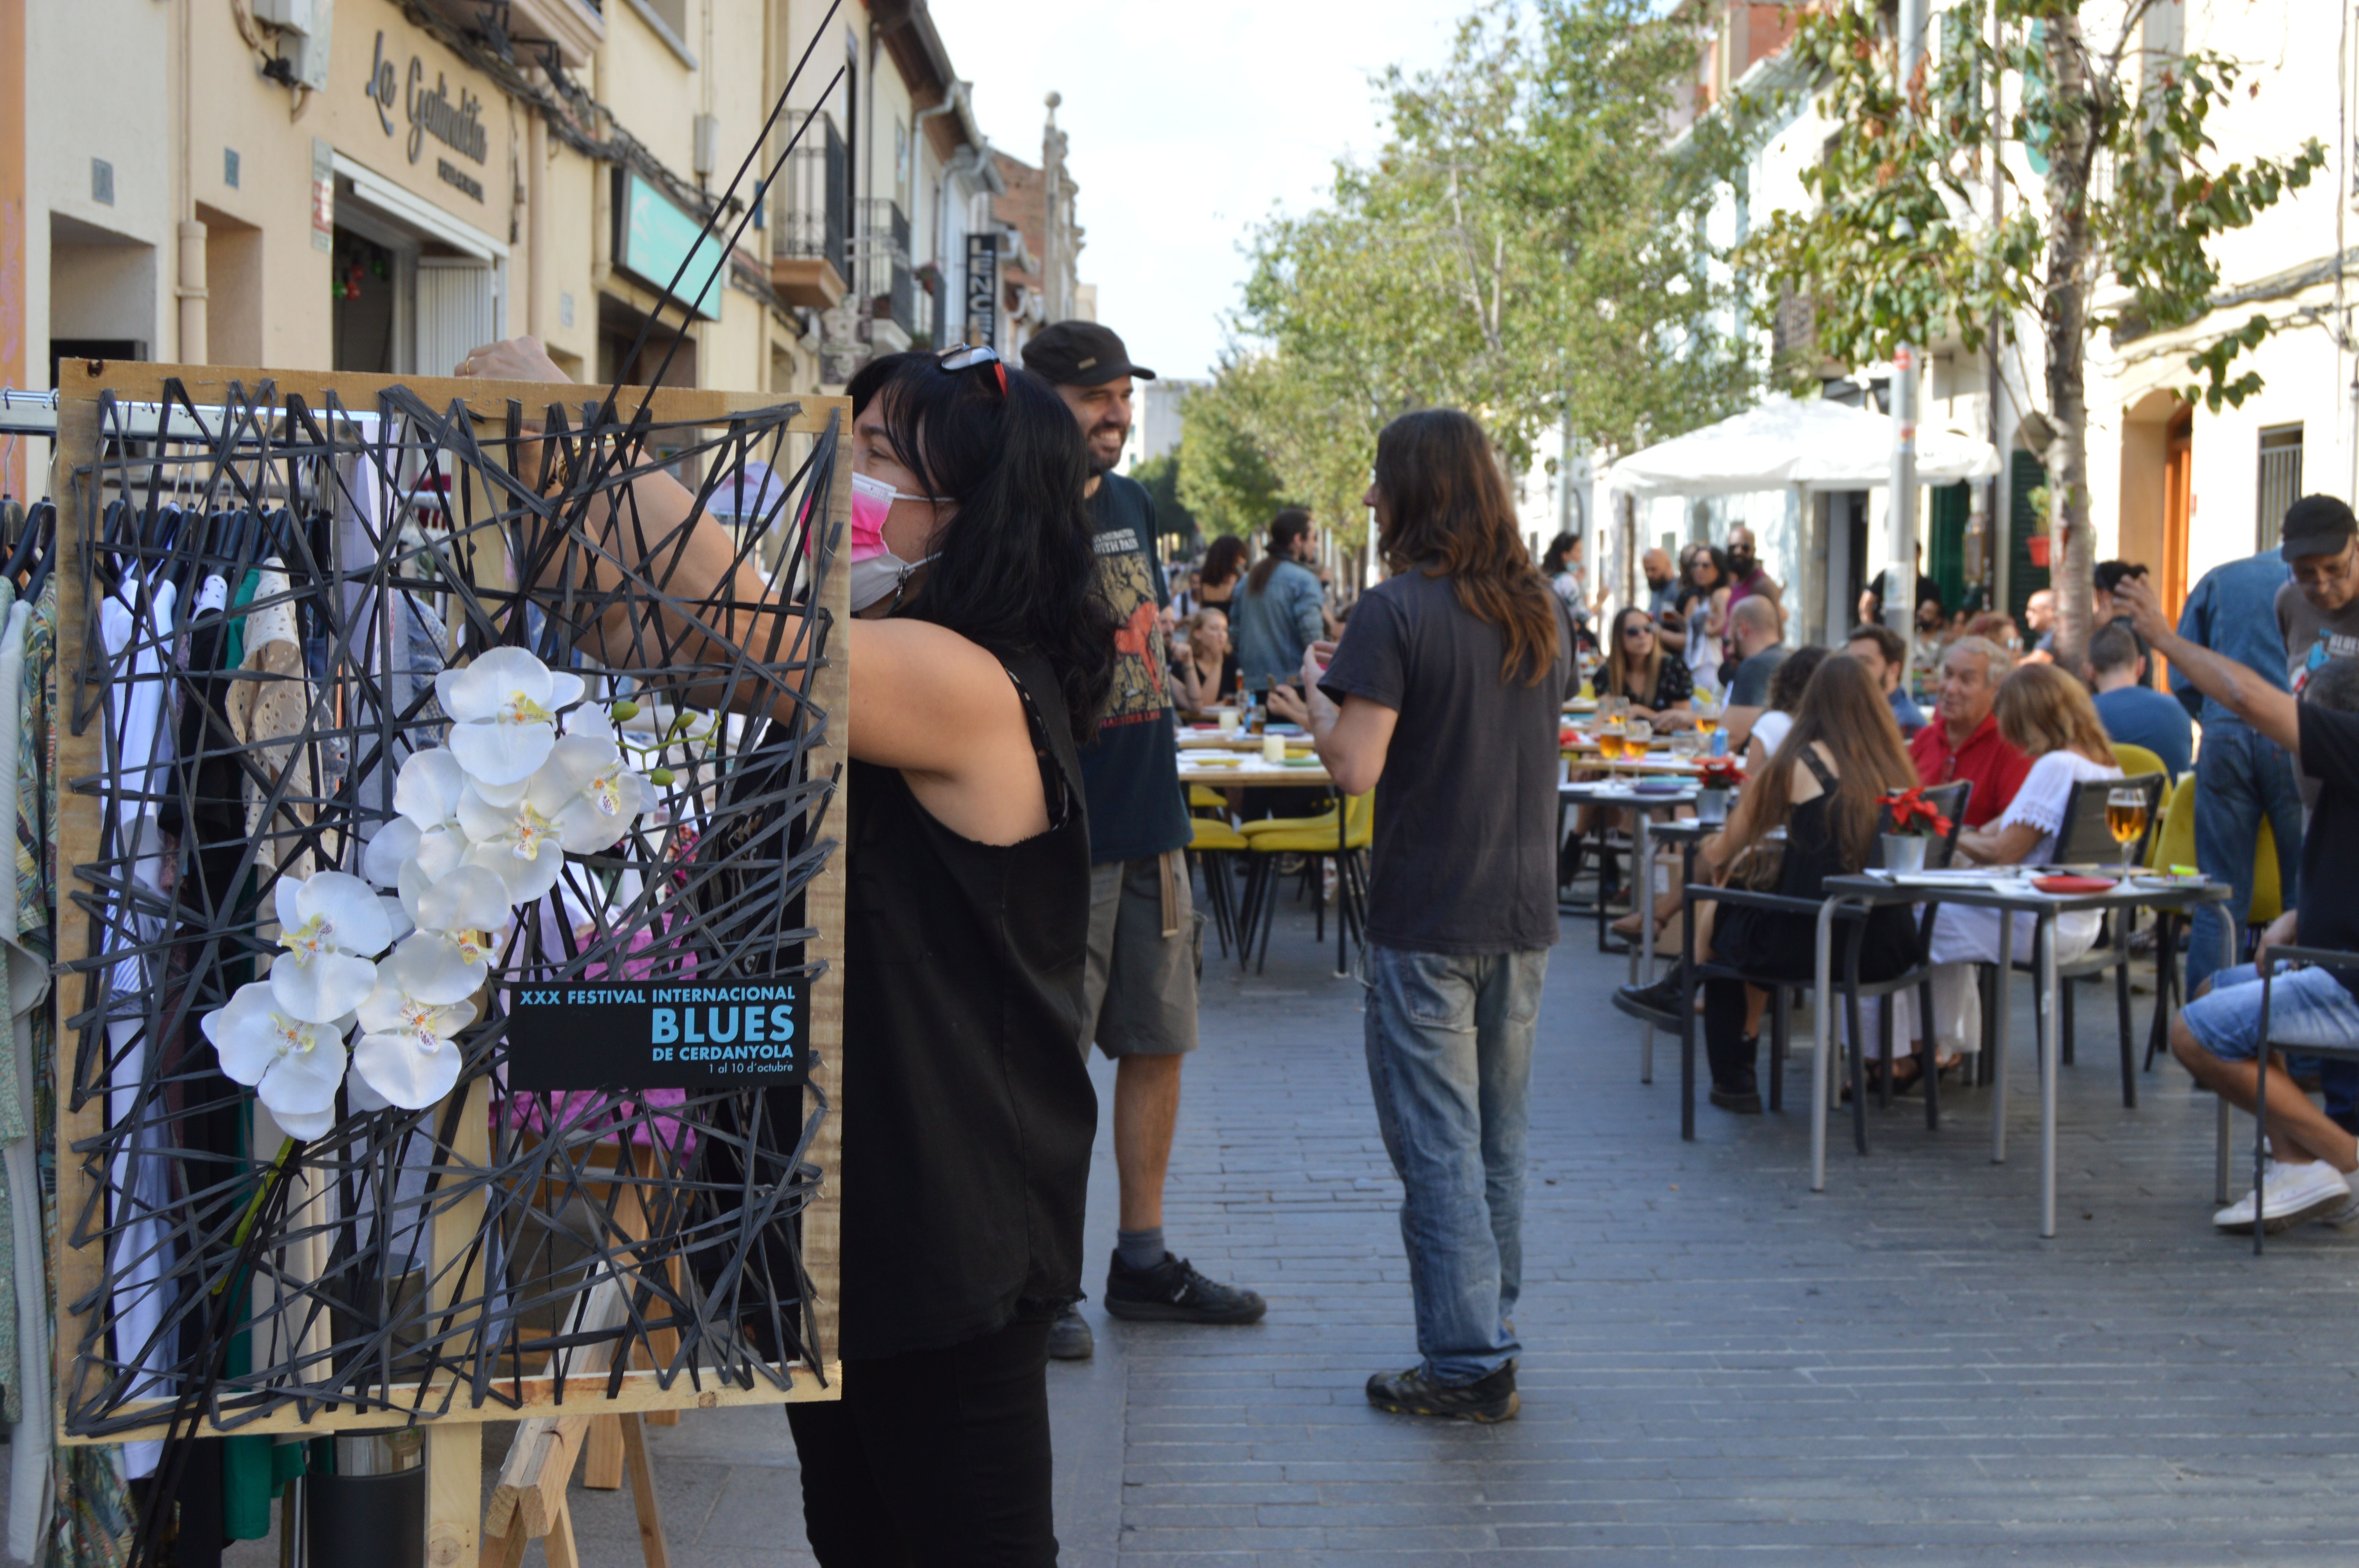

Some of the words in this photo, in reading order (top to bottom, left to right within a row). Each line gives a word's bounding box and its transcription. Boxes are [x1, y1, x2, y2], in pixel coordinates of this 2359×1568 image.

[366, 31, 396, 137] La
[520, 991, 560, 1005] XXX
[568, 989, 646, 1004] FESTIVAL
[652, 985, 795, 1003] INTERNACIONAL
[652, 1004, 794, 1044] BLUES
[652, 1047, 673, 1061] DE
[679, 1044, 793, 1061] CERDANYOLA
[709, 1063, 713, 1074] 1
[718, 1062, 727, 1073] al
[732, 1062, 744, 1073] 10
